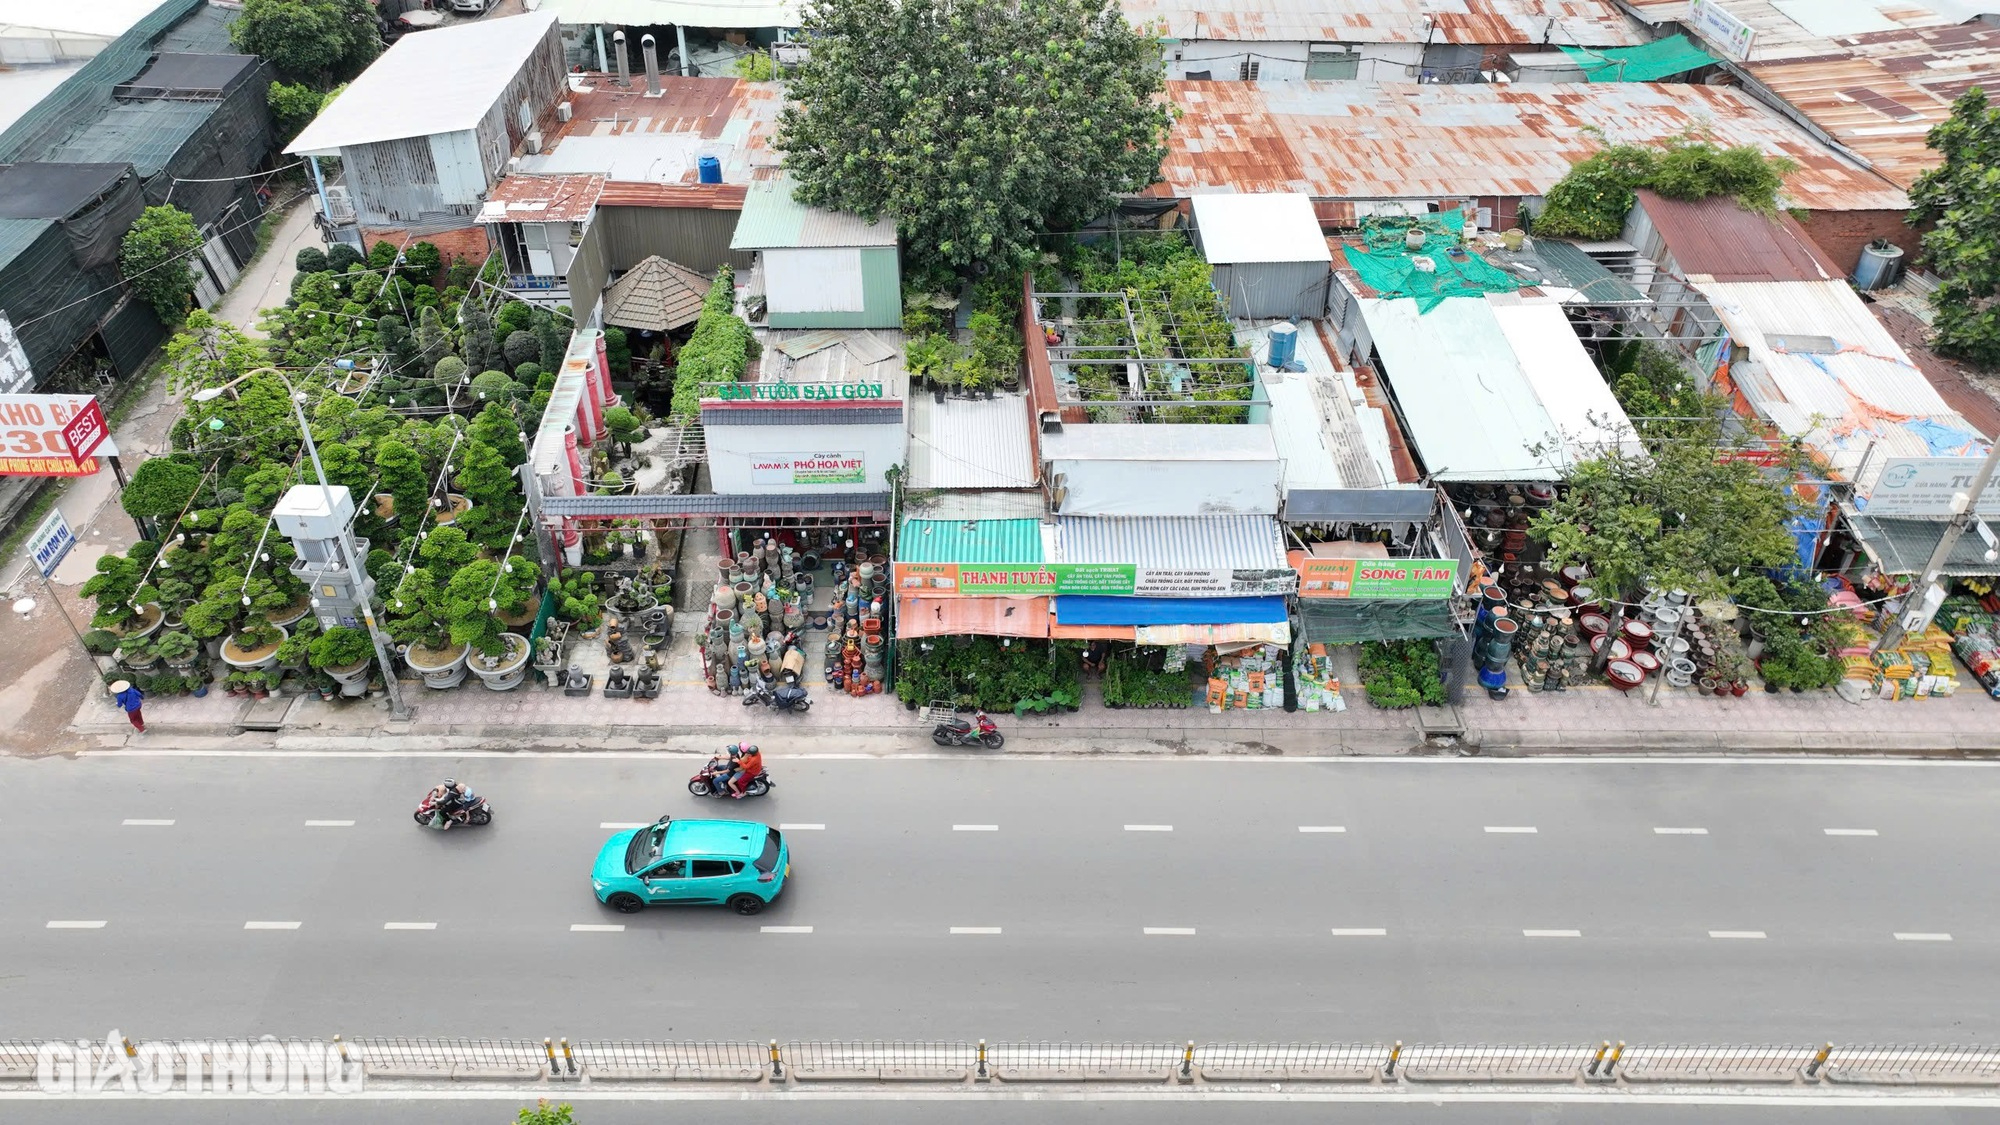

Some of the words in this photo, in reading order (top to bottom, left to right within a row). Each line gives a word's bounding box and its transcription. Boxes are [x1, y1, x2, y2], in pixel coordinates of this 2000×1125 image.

[68, 409, 96, 447] BEST
[0, 430, 69, 453] 30
[794, 459, 815, 469] PHỐ
[818, 460, 839, 469] HOA
[841, 459, 862, 470] VIỆT
[47, 533, 61, 554] BON
[57, 524, 69, 541] SAI
[961, 571, 1008, 584] THANH
[1360, 568, 1407, 580] SONG
[1412, 567, 1451, 580] TÂM
